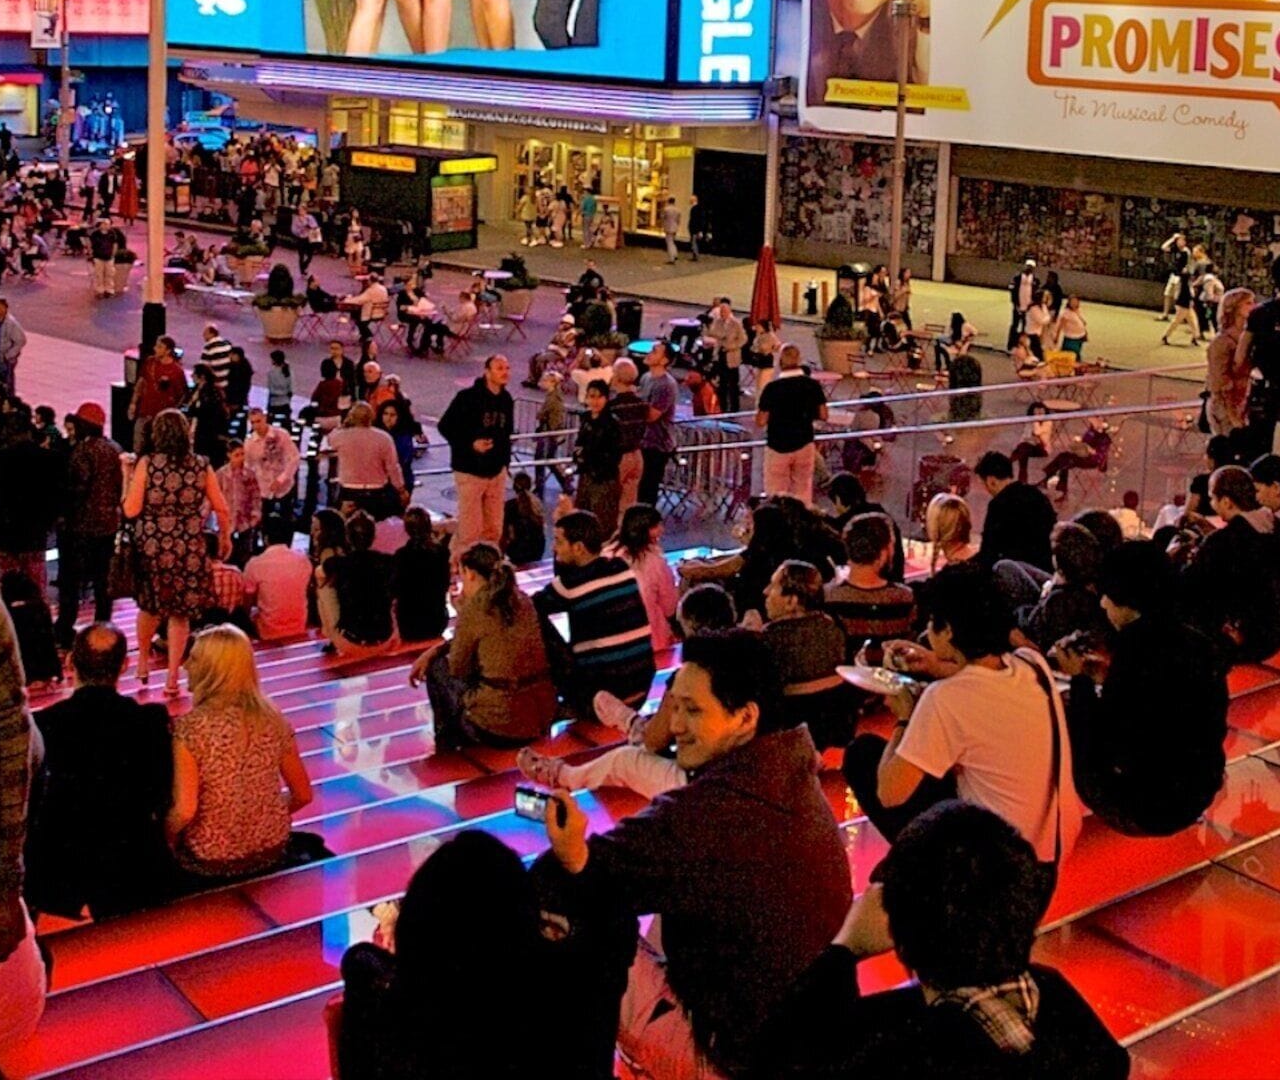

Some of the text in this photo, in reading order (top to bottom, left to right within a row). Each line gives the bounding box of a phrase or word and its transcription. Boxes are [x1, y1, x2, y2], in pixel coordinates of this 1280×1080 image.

[1053, 89, 1250, 140] The Musical Comedy
